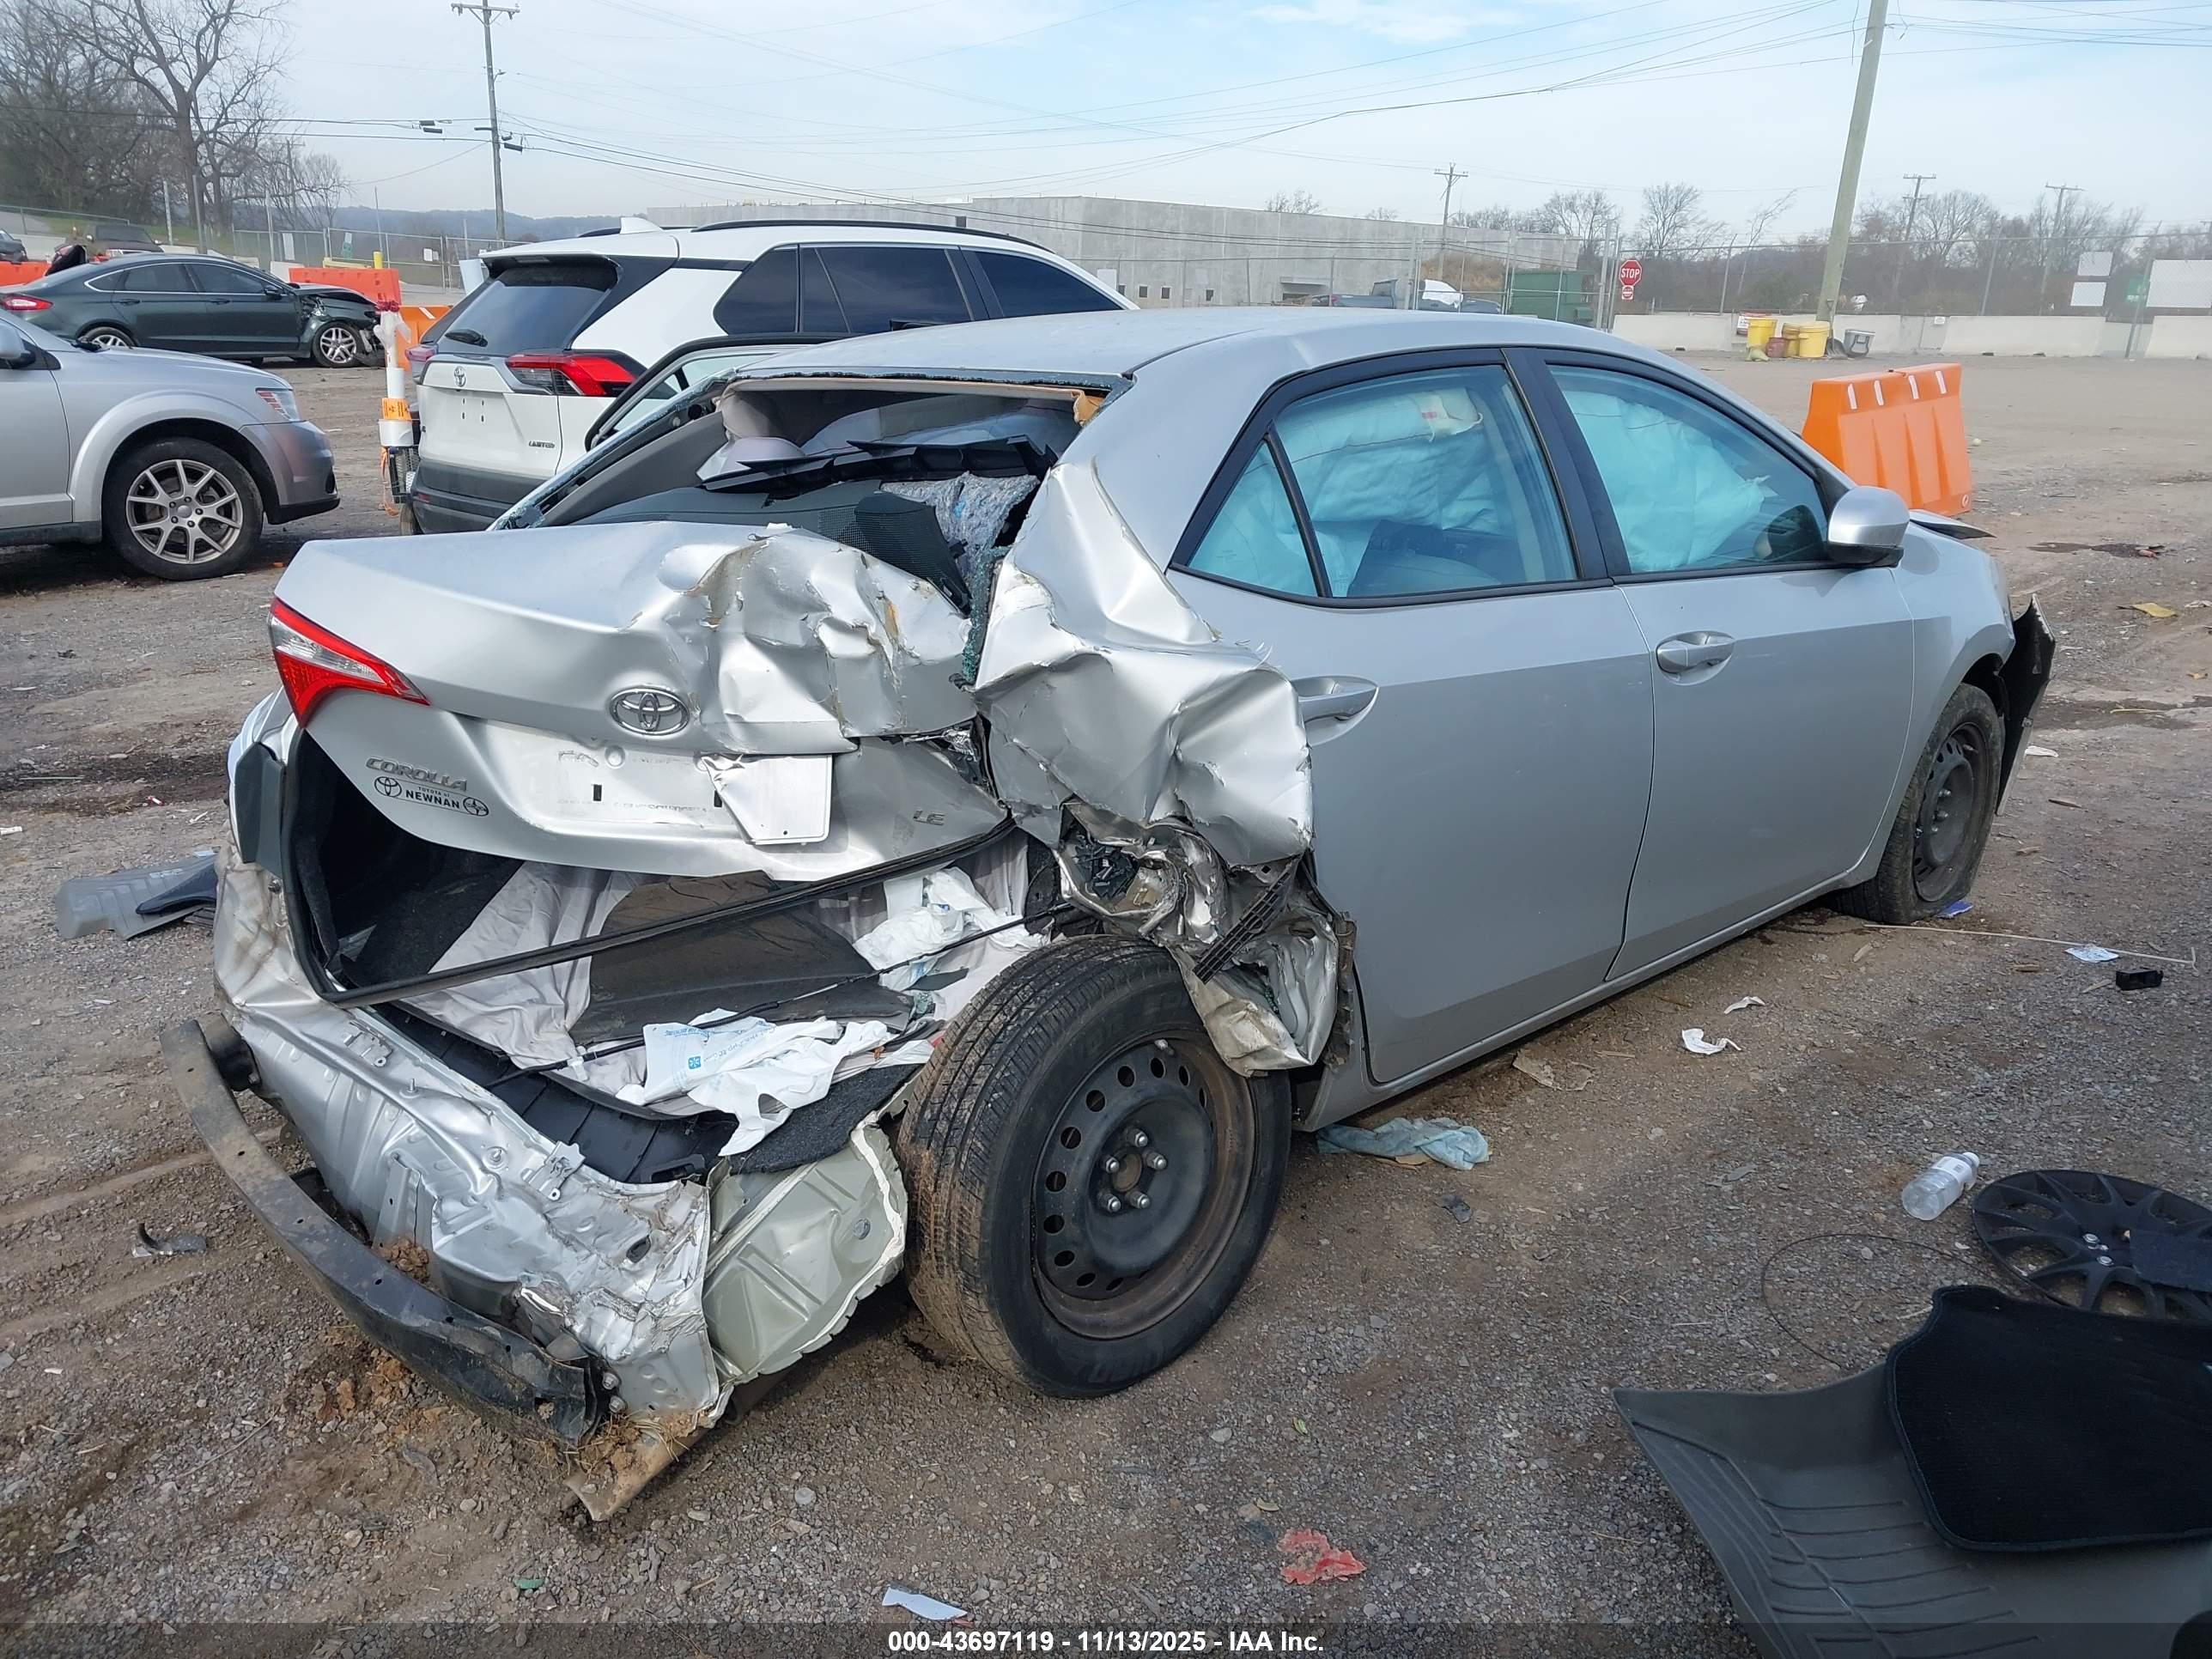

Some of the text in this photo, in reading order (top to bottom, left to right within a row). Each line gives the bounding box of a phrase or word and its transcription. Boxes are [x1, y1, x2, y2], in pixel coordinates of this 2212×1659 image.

[1621, 268, 1640, 279] STOP
[366, 757, 467, 792] COROLLA
[418, 787, 441, 795] TOYOTA
[405, 790, 460, 809] NEWNAN
[913, 809, 945, 825] LE
